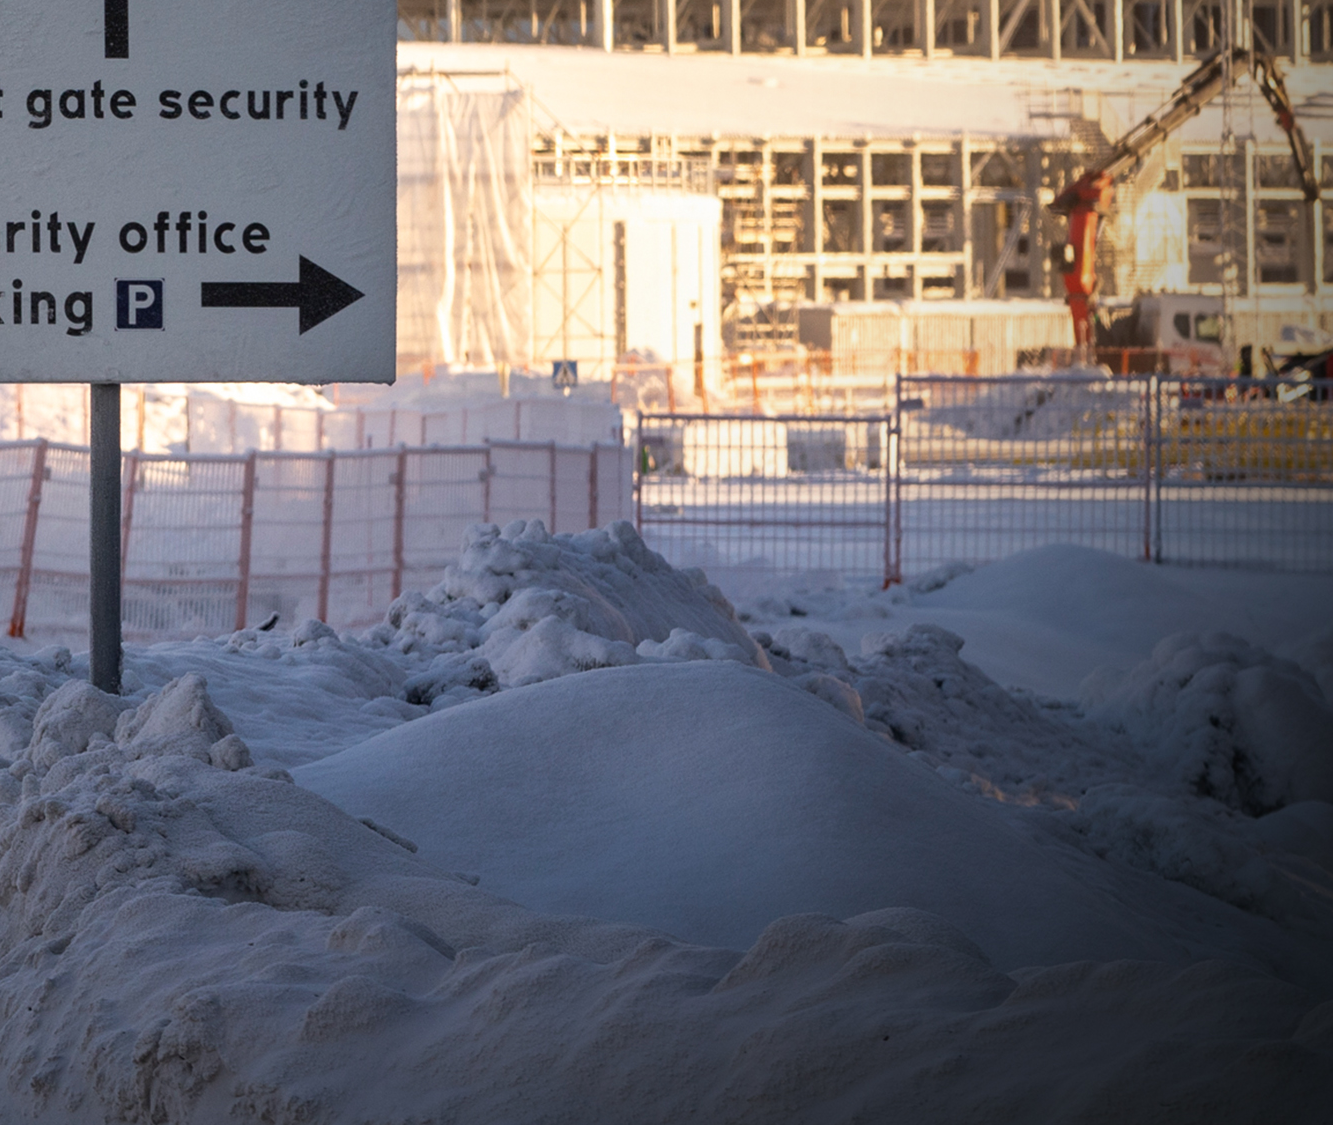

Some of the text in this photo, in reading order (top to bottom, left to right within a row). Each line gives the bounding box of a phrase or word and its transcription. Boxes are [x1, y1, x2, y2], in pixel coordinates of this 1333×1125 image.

[27, 79, 137, 130] gate
[158, 79, 359, 131] security
[118, 210, 271, 255] office
